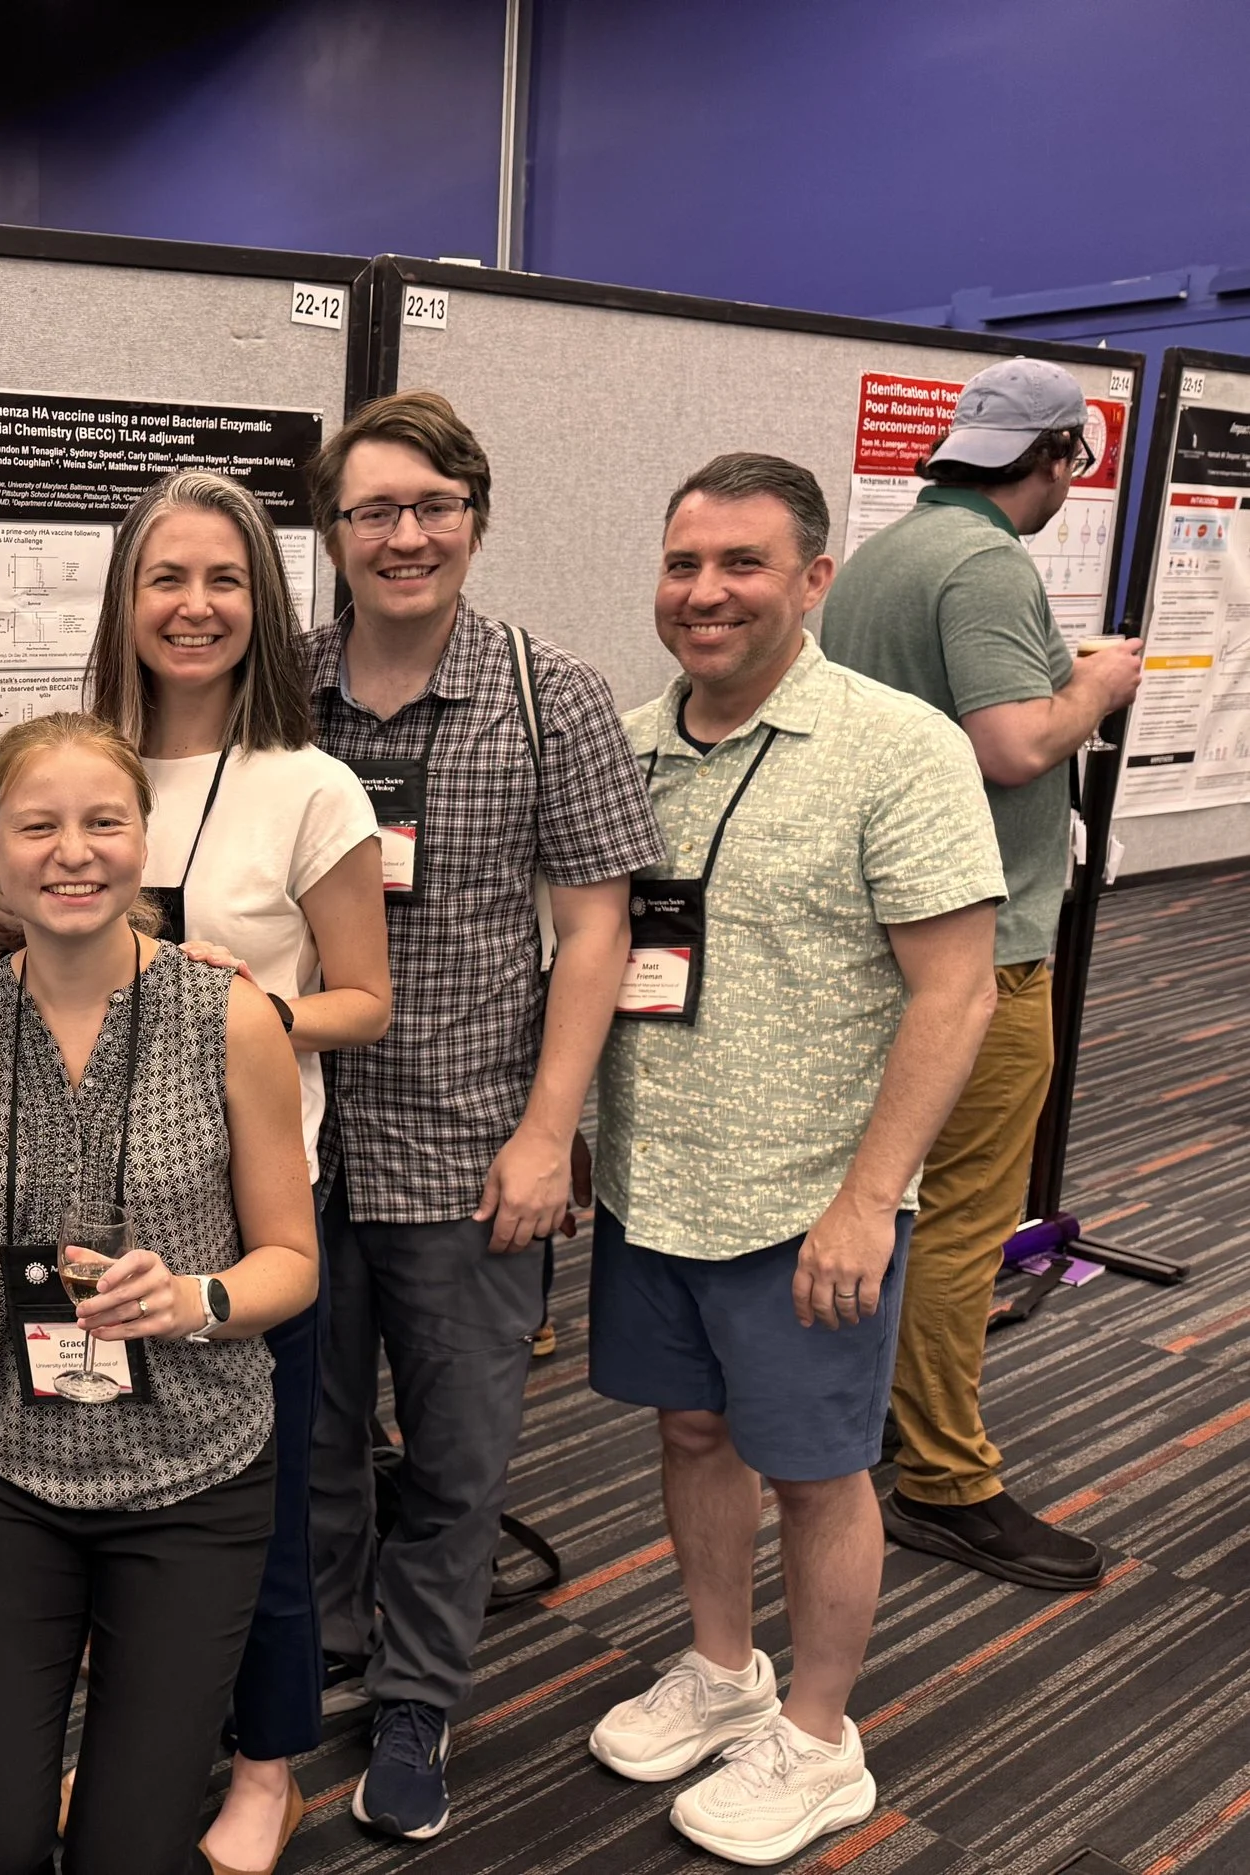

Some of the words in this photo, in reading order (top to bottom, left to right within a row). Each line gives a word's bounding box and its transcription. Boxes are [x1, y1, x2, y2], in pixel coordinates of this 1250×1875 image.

[295, 292, 340, 320] 22-12
[406, 295, 445, 320] 22-13
[866, 381, 929, 400] Identification
[931, 388, 940, 401] of
[1110, 376, 1130, 392] 22-14
[1182, 376, 1203, 393] 22-15
[865, 400, 889, 414] Poor
[891, 401, 934, 417] Rotavirus
[936, 406, 955, 419] Vacc
[32, 406, 49, 419] HA
[51, 410, 94, 422] vaccine
[97, 412, 128, 426] using
[131, 415, 137, 424] a
[140, 415, 169, 426] novel
[172, 415, 217, 428] Bacterial
[220, 417, 271, 432] Enzymatic
[863, 418, 936, 435] Seroconversion
[14, 423, 72, 440] Chemistry
[75, 427, 115, 442] (BECC)
[118, 428, 146, 442] TLR4
[148, 431, 194, 445] adjuvant
[21, 445, 29, 454] M
[69, 448, 97, 459] Sydney
[127, 450, 147, 462] Carly
[13, 537, 43, 545] challenge
[73, 530, 100, 538] following
[50, 676, 72, 684] domain
